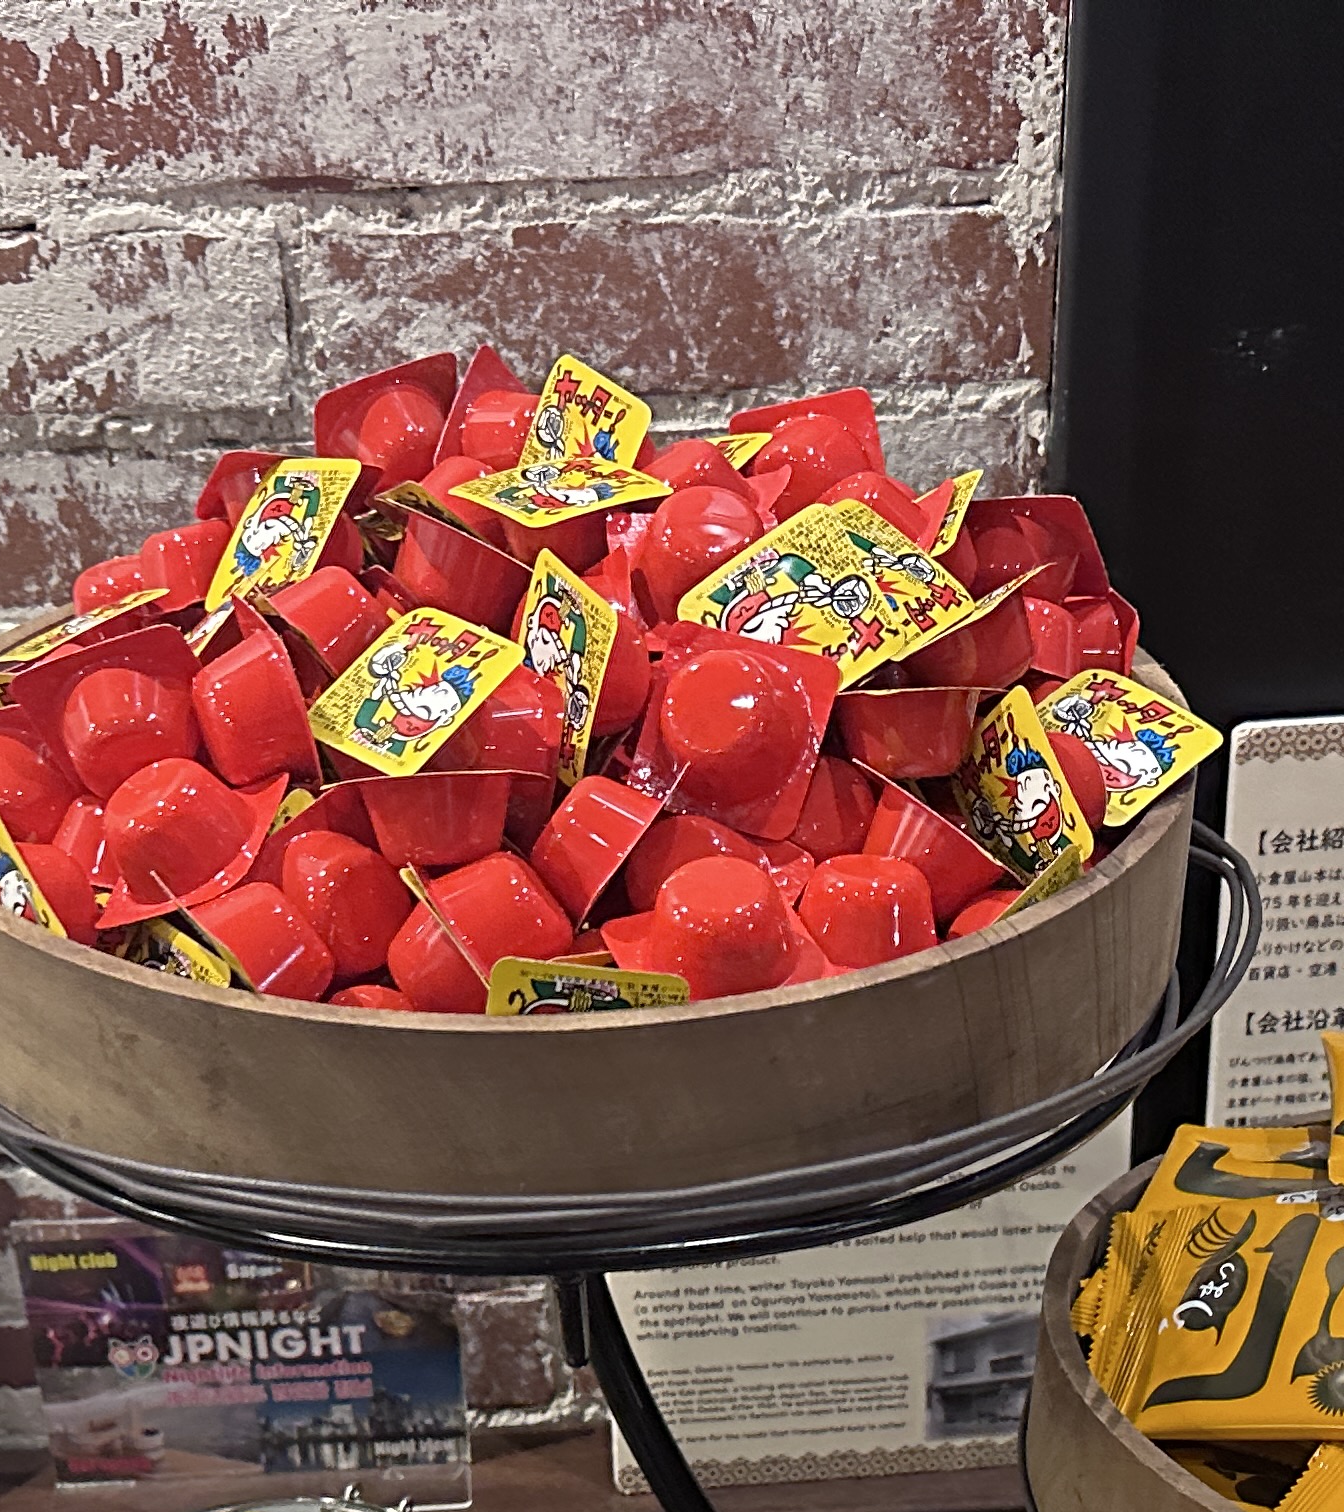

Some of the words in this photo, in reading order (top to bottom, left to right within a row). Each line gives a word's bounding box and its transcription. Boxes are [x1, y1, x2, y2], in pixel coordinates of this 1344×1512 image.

[899, 1231, 926, 1244] kelp
[929, 1230, 957, 1241] that
[30, 1253, 76, 1272] Night
[80, 1251, 118, 1269] club
[634, 1287, 681, 1300] Around
[684, 1286, 710, 1297] that
[163, 1324, 367, 1366] JPNIGHT
